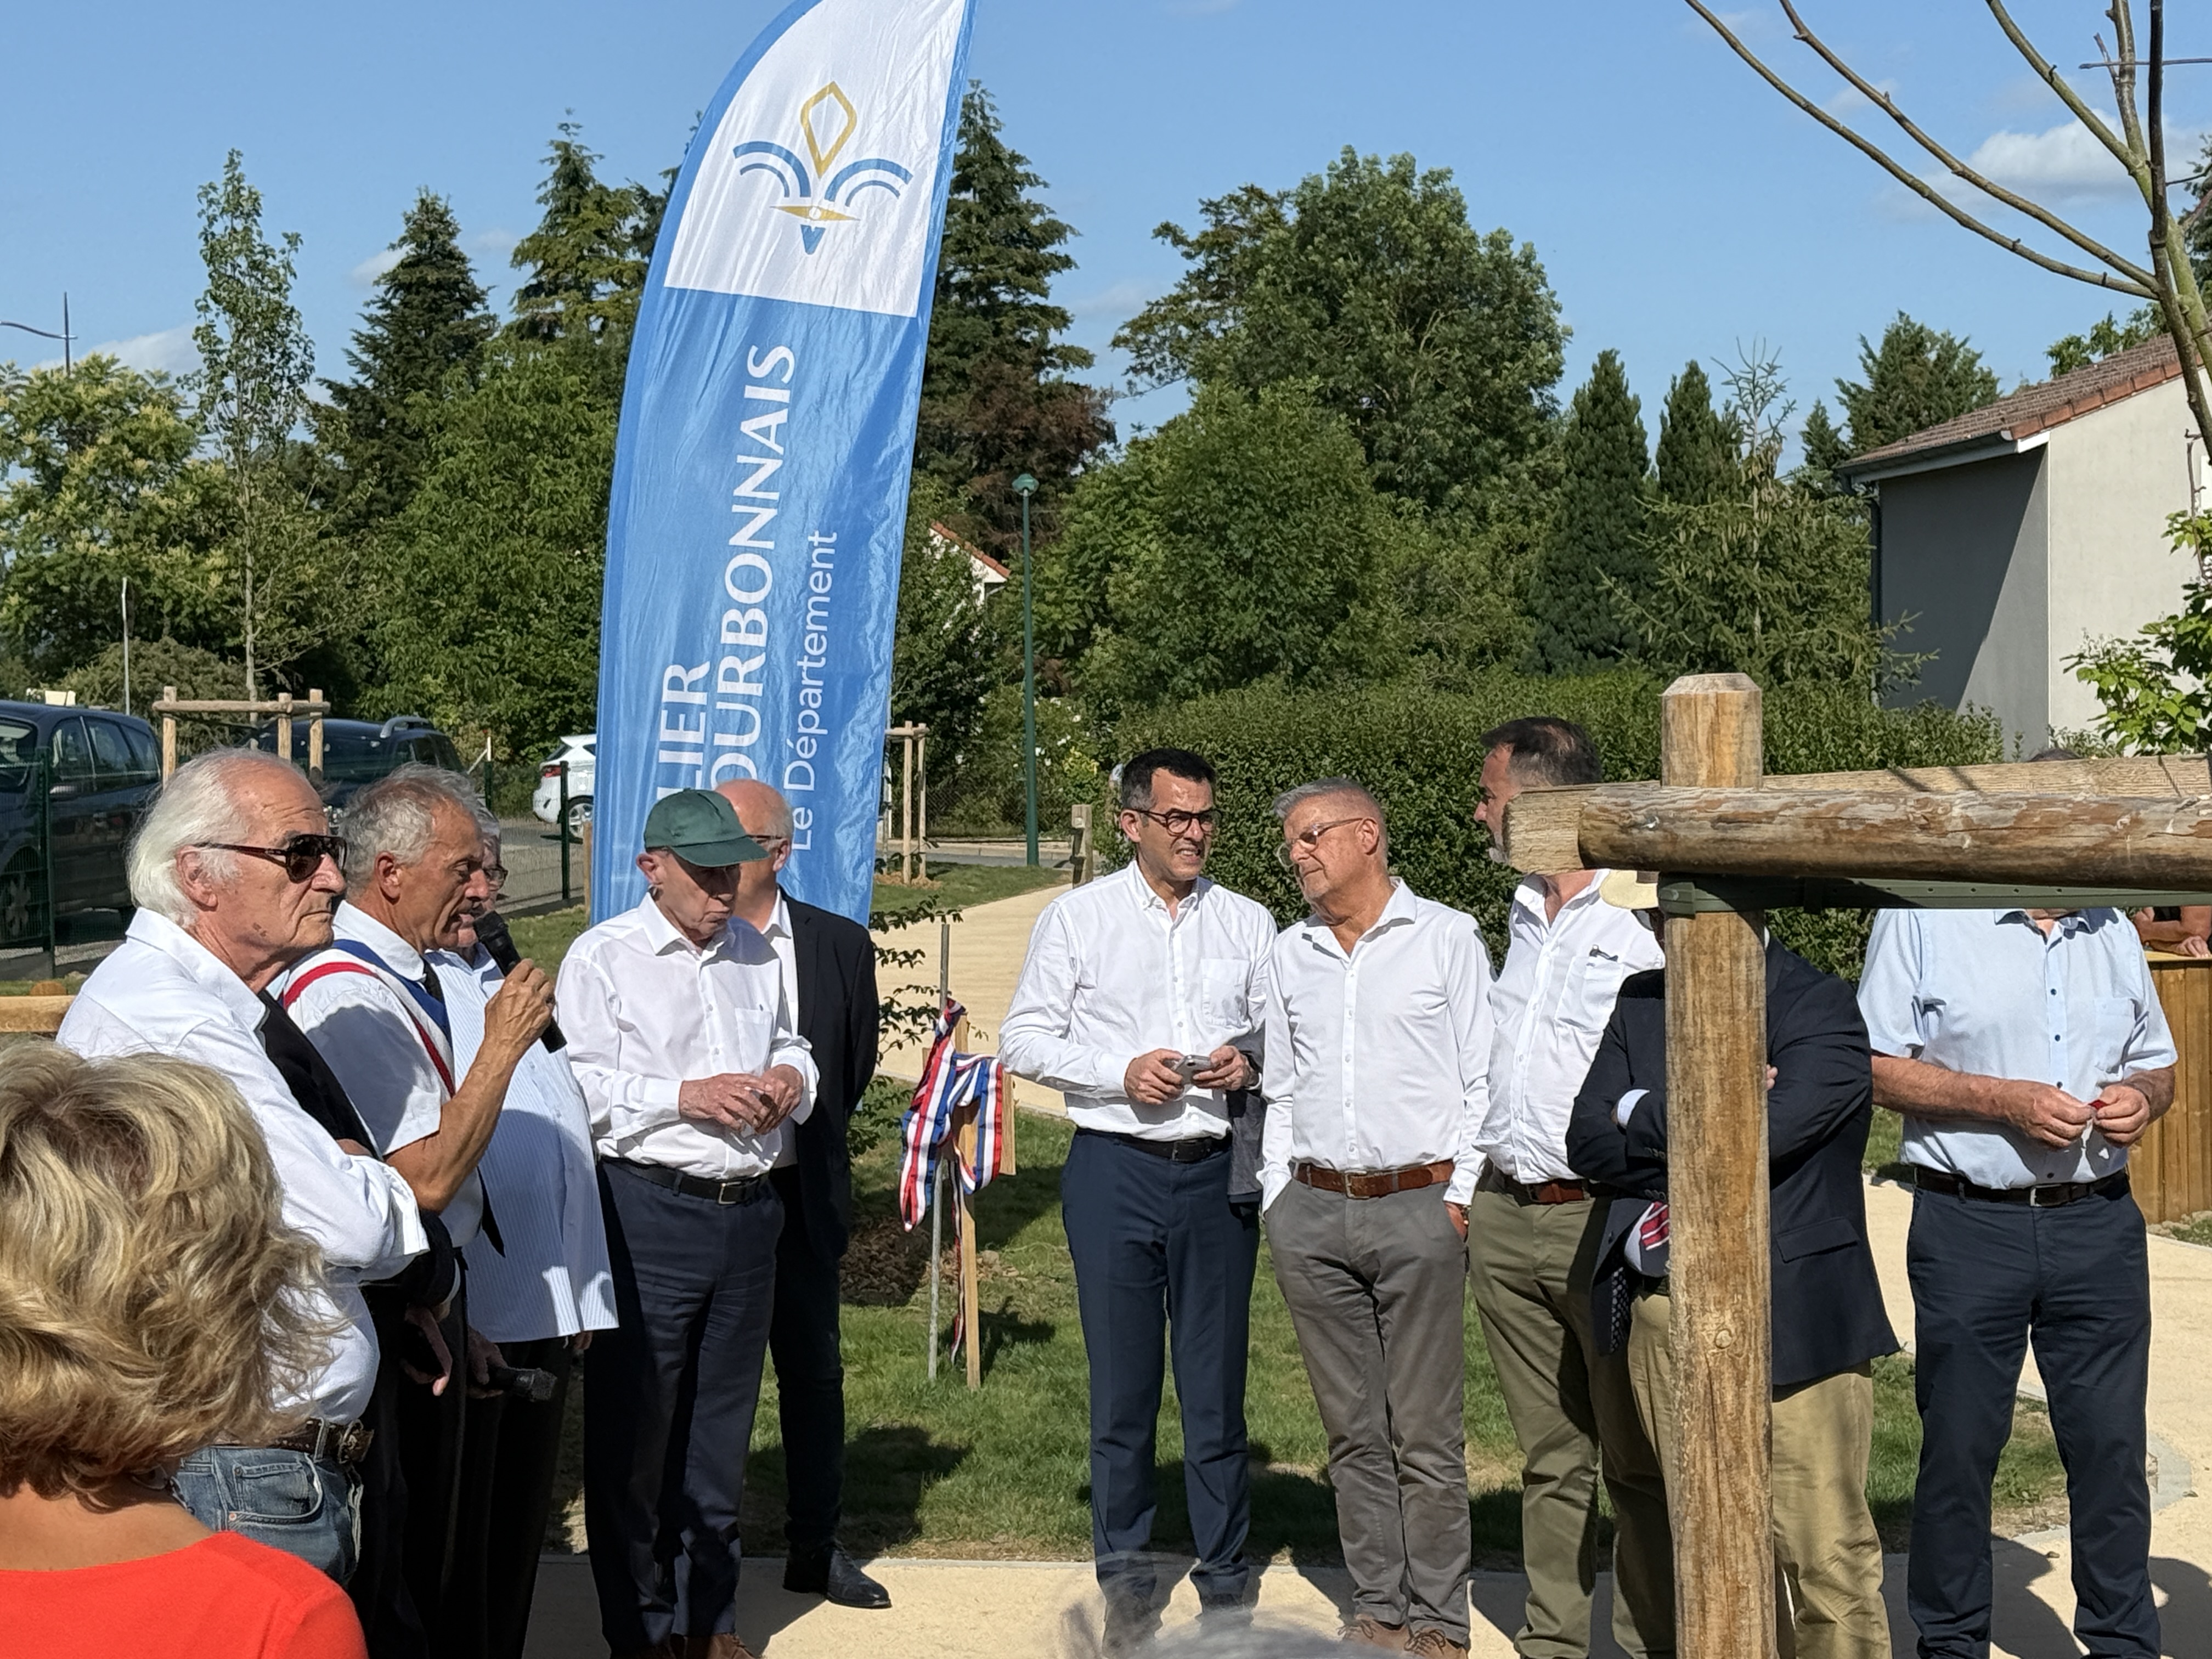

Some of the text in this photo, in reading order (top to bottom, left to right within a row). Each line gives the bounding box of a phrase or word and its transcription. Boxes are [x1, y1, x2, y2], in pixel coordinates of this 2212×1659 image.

[710, 345, 795, 791] OURBONNAIS
[783, 530, 837, 850] Le Département
[657, 661, 710, 800] LIER
